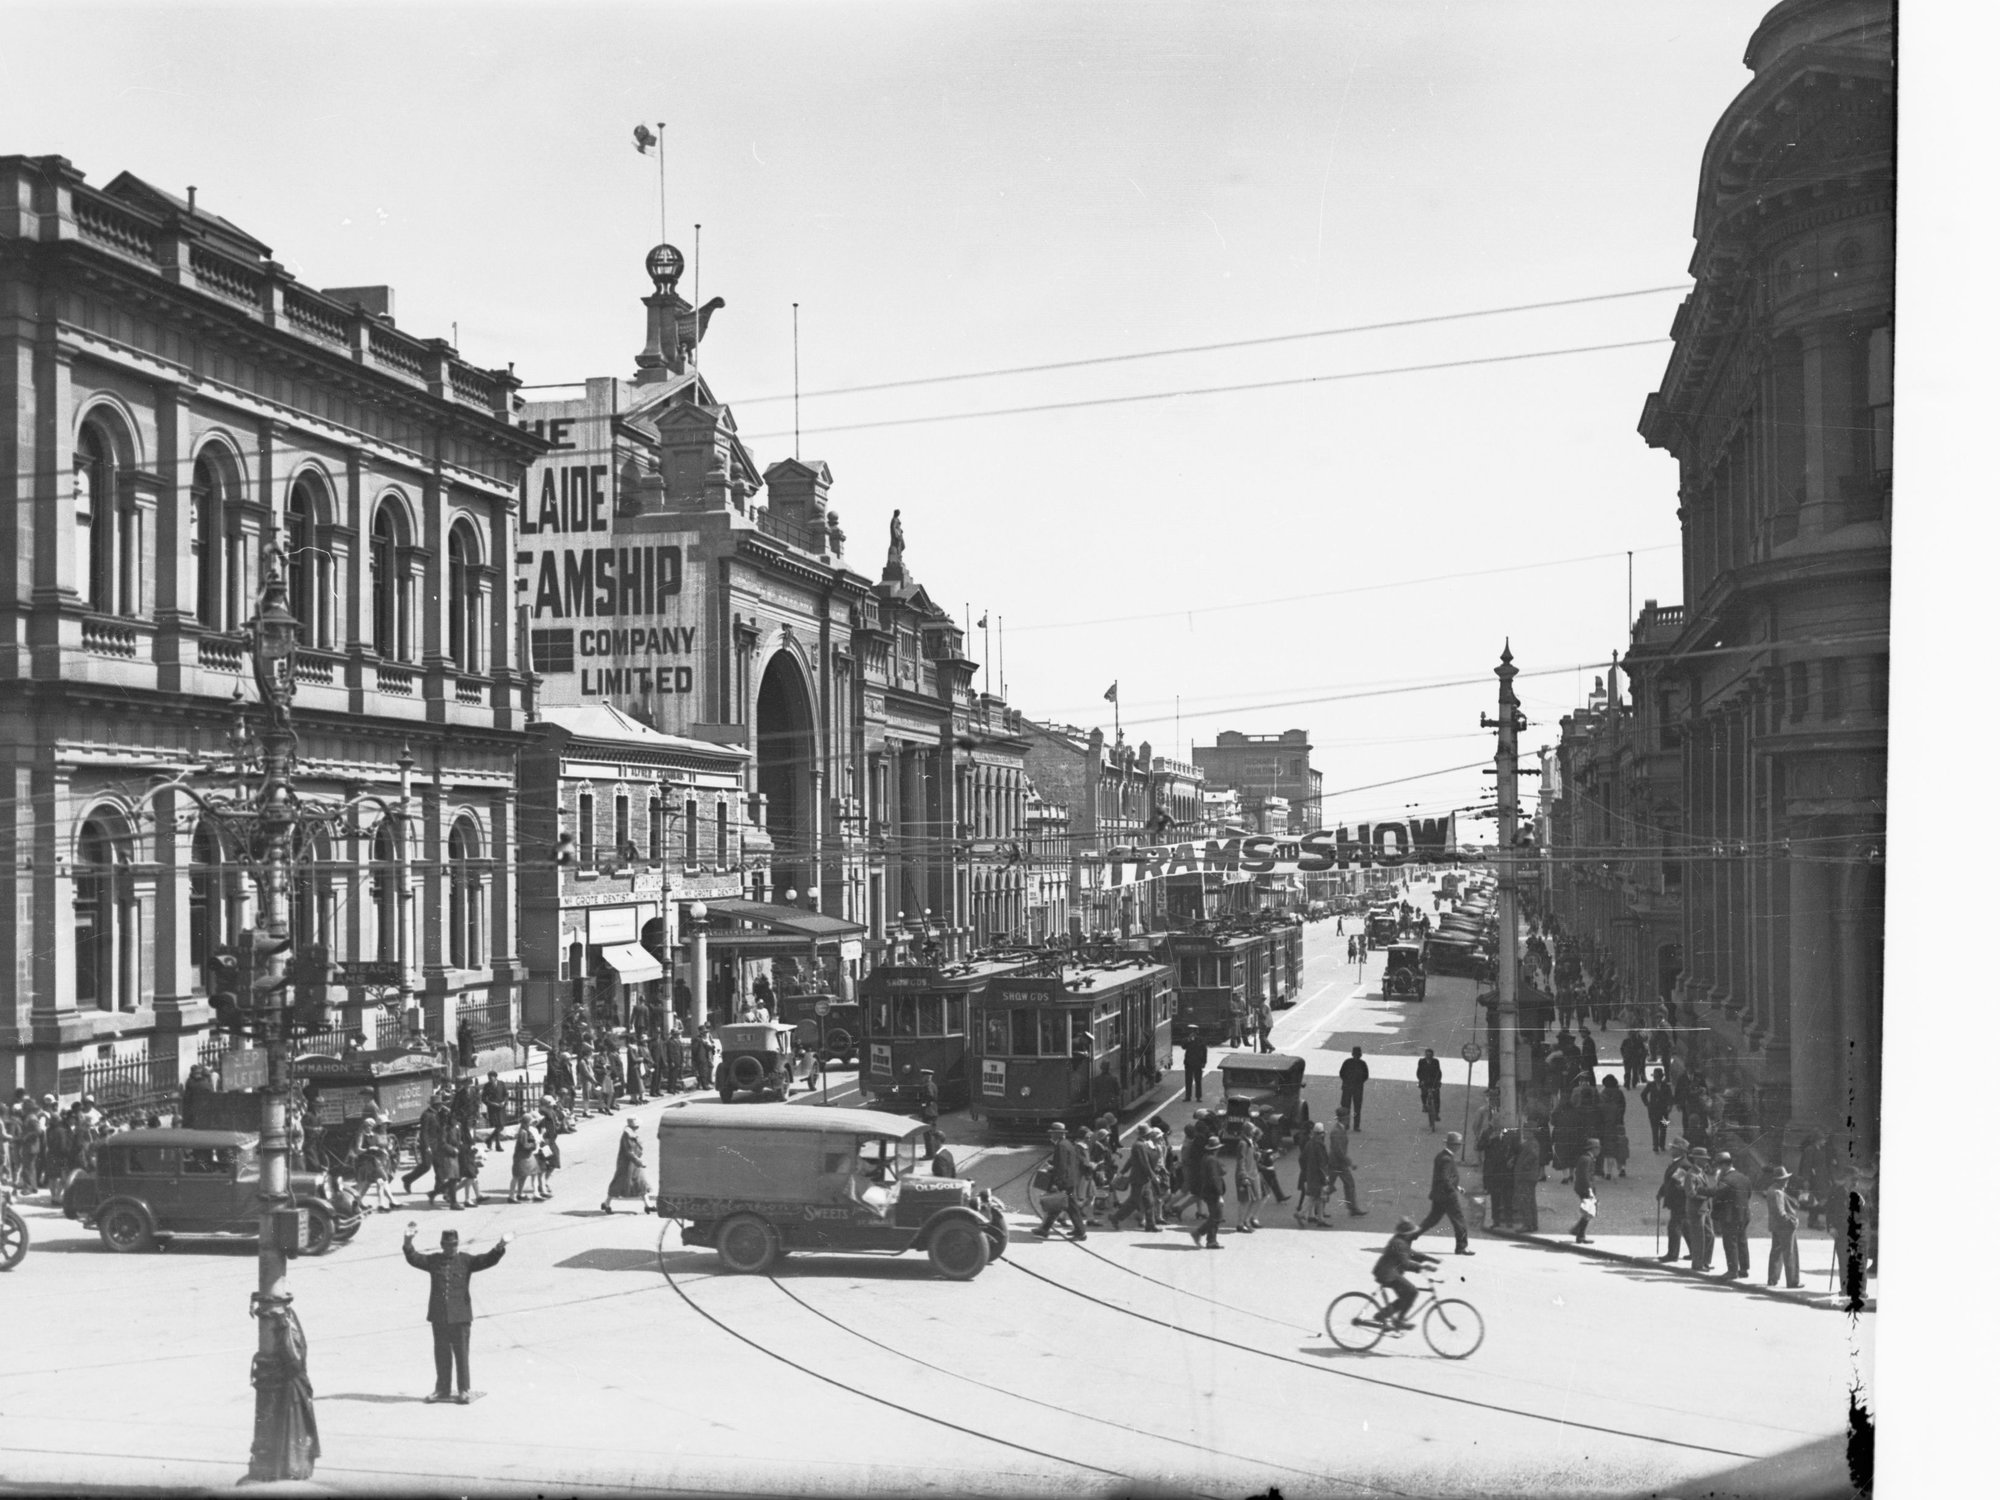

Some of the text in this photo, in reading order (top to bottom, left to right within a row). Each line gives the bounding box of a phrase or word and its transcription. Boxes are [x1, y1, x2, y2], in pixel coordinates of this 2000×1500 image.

[519, 465, 608, 535] LAIDE
[580, 626, 696, 657] COMPANY
[581, 666, 693, 696] LIMITED
[1107, 836, 1278, 887] TRAMS
[1297, 817, 1449, 871] SHOW
[576, 895, 598, 905] GROTE
[1002, 991, 1028, 1001] SHOW
